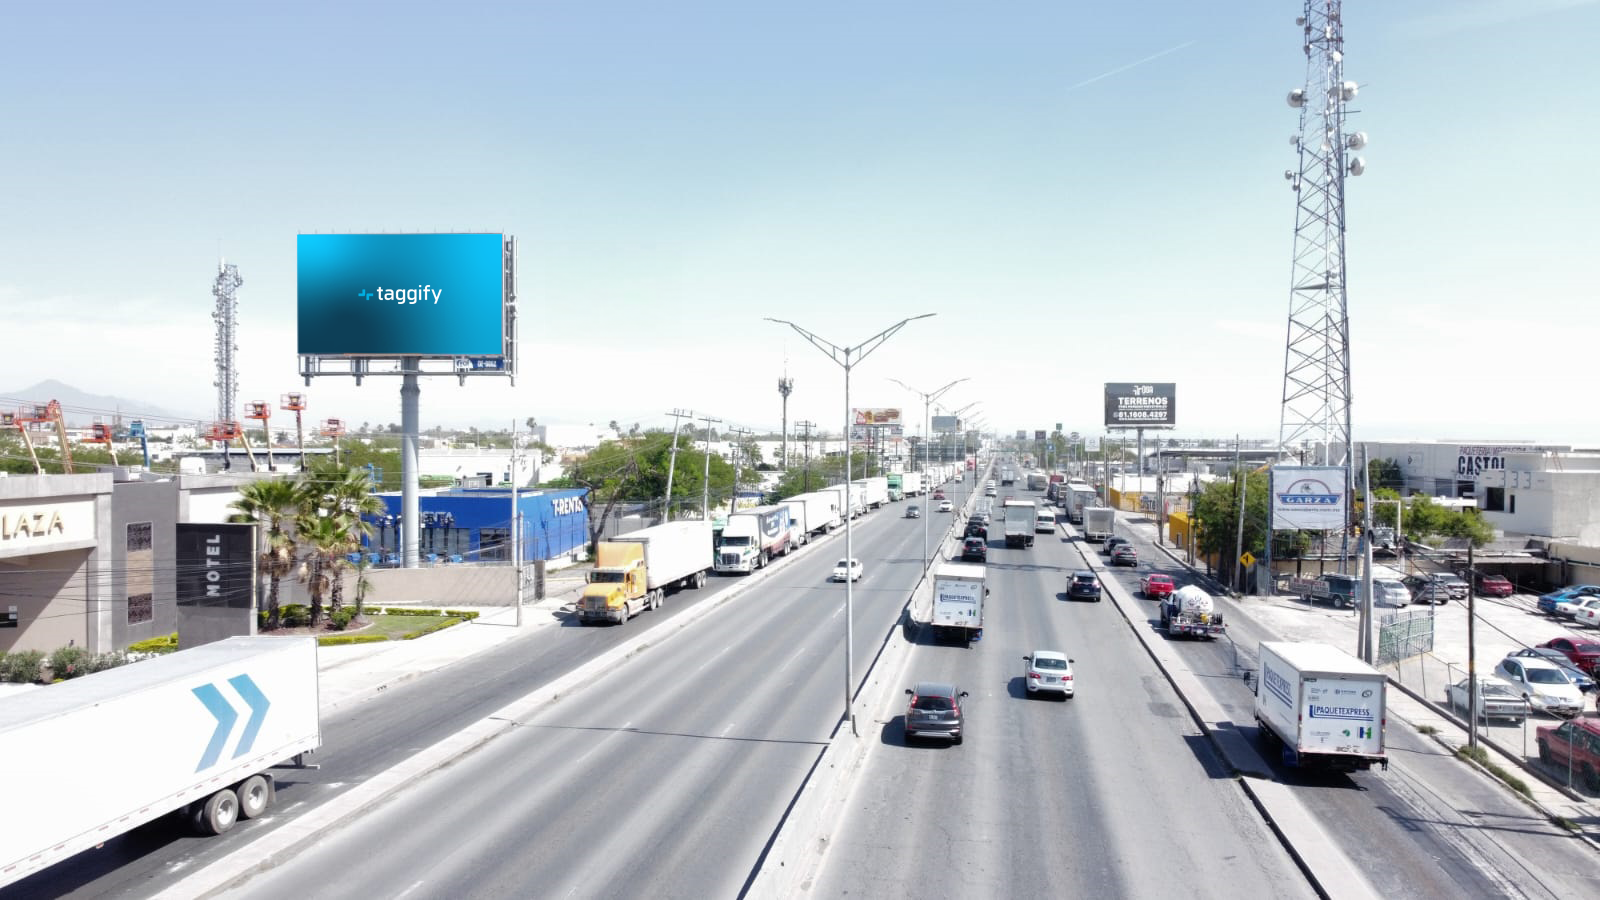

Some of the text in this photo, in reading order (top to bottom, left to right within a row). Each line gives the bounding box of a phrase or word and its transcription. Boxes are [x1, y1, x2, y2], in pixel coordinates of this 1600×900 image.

[376, 284, 443, 305] taggify
[1118, 397, 1168, 405] TERRENOS
[205, 534, 221, 597] MOTEL
[1315, 705, 1371, 716] PAQUETEXPRESS
